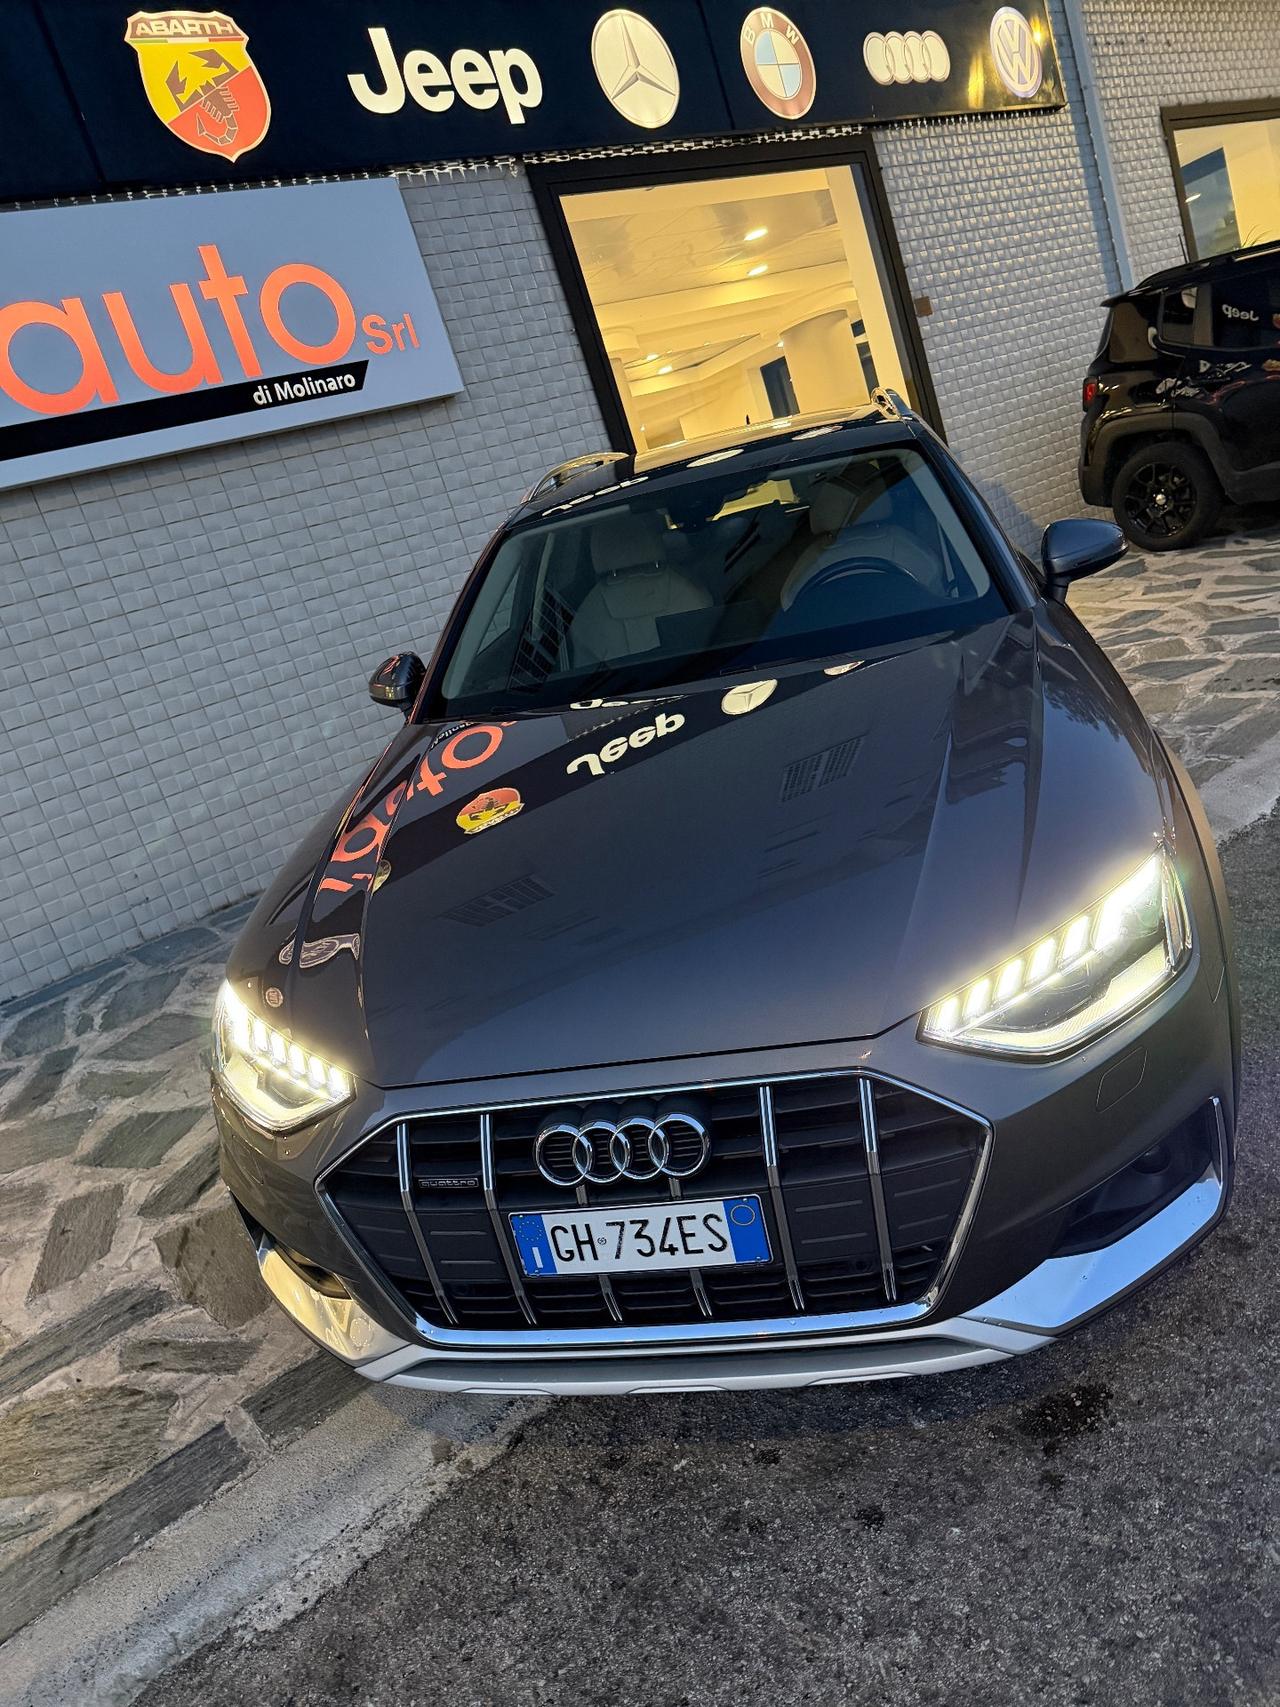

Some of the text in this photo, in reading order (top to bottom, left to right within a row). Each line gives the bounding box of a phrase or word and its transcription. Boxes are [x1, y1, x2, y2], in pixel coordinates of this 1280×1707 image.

[135, 19, 234, 36] ABARTH
[743, 12, 800, 46] BMW
[347, 27, 543, 124] Jeep
[0, 244, 421, 415] auto Srl
[252, 373, 356, 406] di Molinaro
[421, 1180, 476, 1188] quattro
